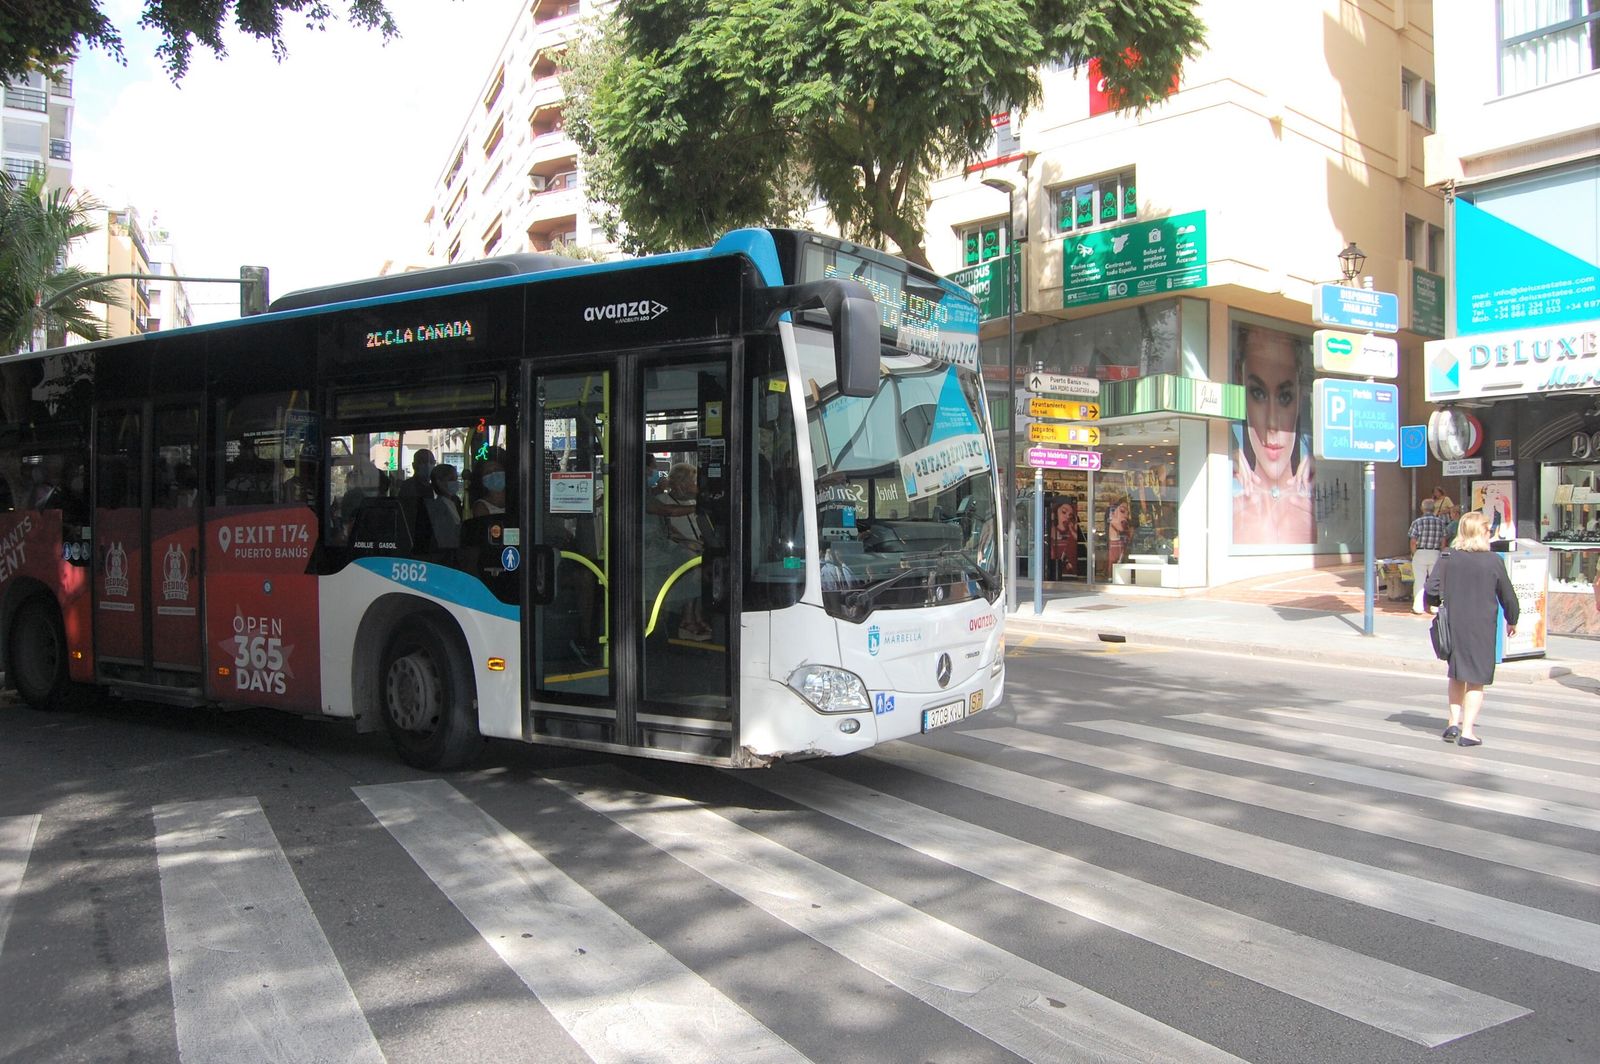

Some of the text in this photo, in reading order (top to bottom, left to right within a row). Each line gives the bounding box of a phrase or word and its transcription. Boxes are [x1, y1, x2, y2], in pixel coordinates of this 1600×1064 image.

[954, 264, 990, 284] campus
[1494, 276, 1595, 297] info@deluxestates.com
[1497, 285, 1596, 305] www.deluxestates.com
[583, 300, 650, 322] avanza
[1546, 298, 1561, 307] 170
[417, 320, 472, 341] CAÑADA
[1050, 376, 1066, 384] Puerto
[1032, 400, 1066, 409] Ayuntamiento
[1331, 395, 1346, 422] P
[1354, 409, 1376, 420] PLAZA
[1364, 421, 1395, 431] VICTORIA
[235, 524, 309, 544] EXIT 174
[235, 545, 308, 559] PUERTO BANÚS
[354, 541, 374, 549] ADBLUE
[391, 562, 427, 582] 5862
[233, 616, 282, 636] OPEN
[968, 614, 993, 632] avanza
[884, 632, 922, 645] MARBELLA
[234, 634, 283, 671] 365
[236, 667, 286, 694] DAYS
[930, 707, 949, 728] 3709
